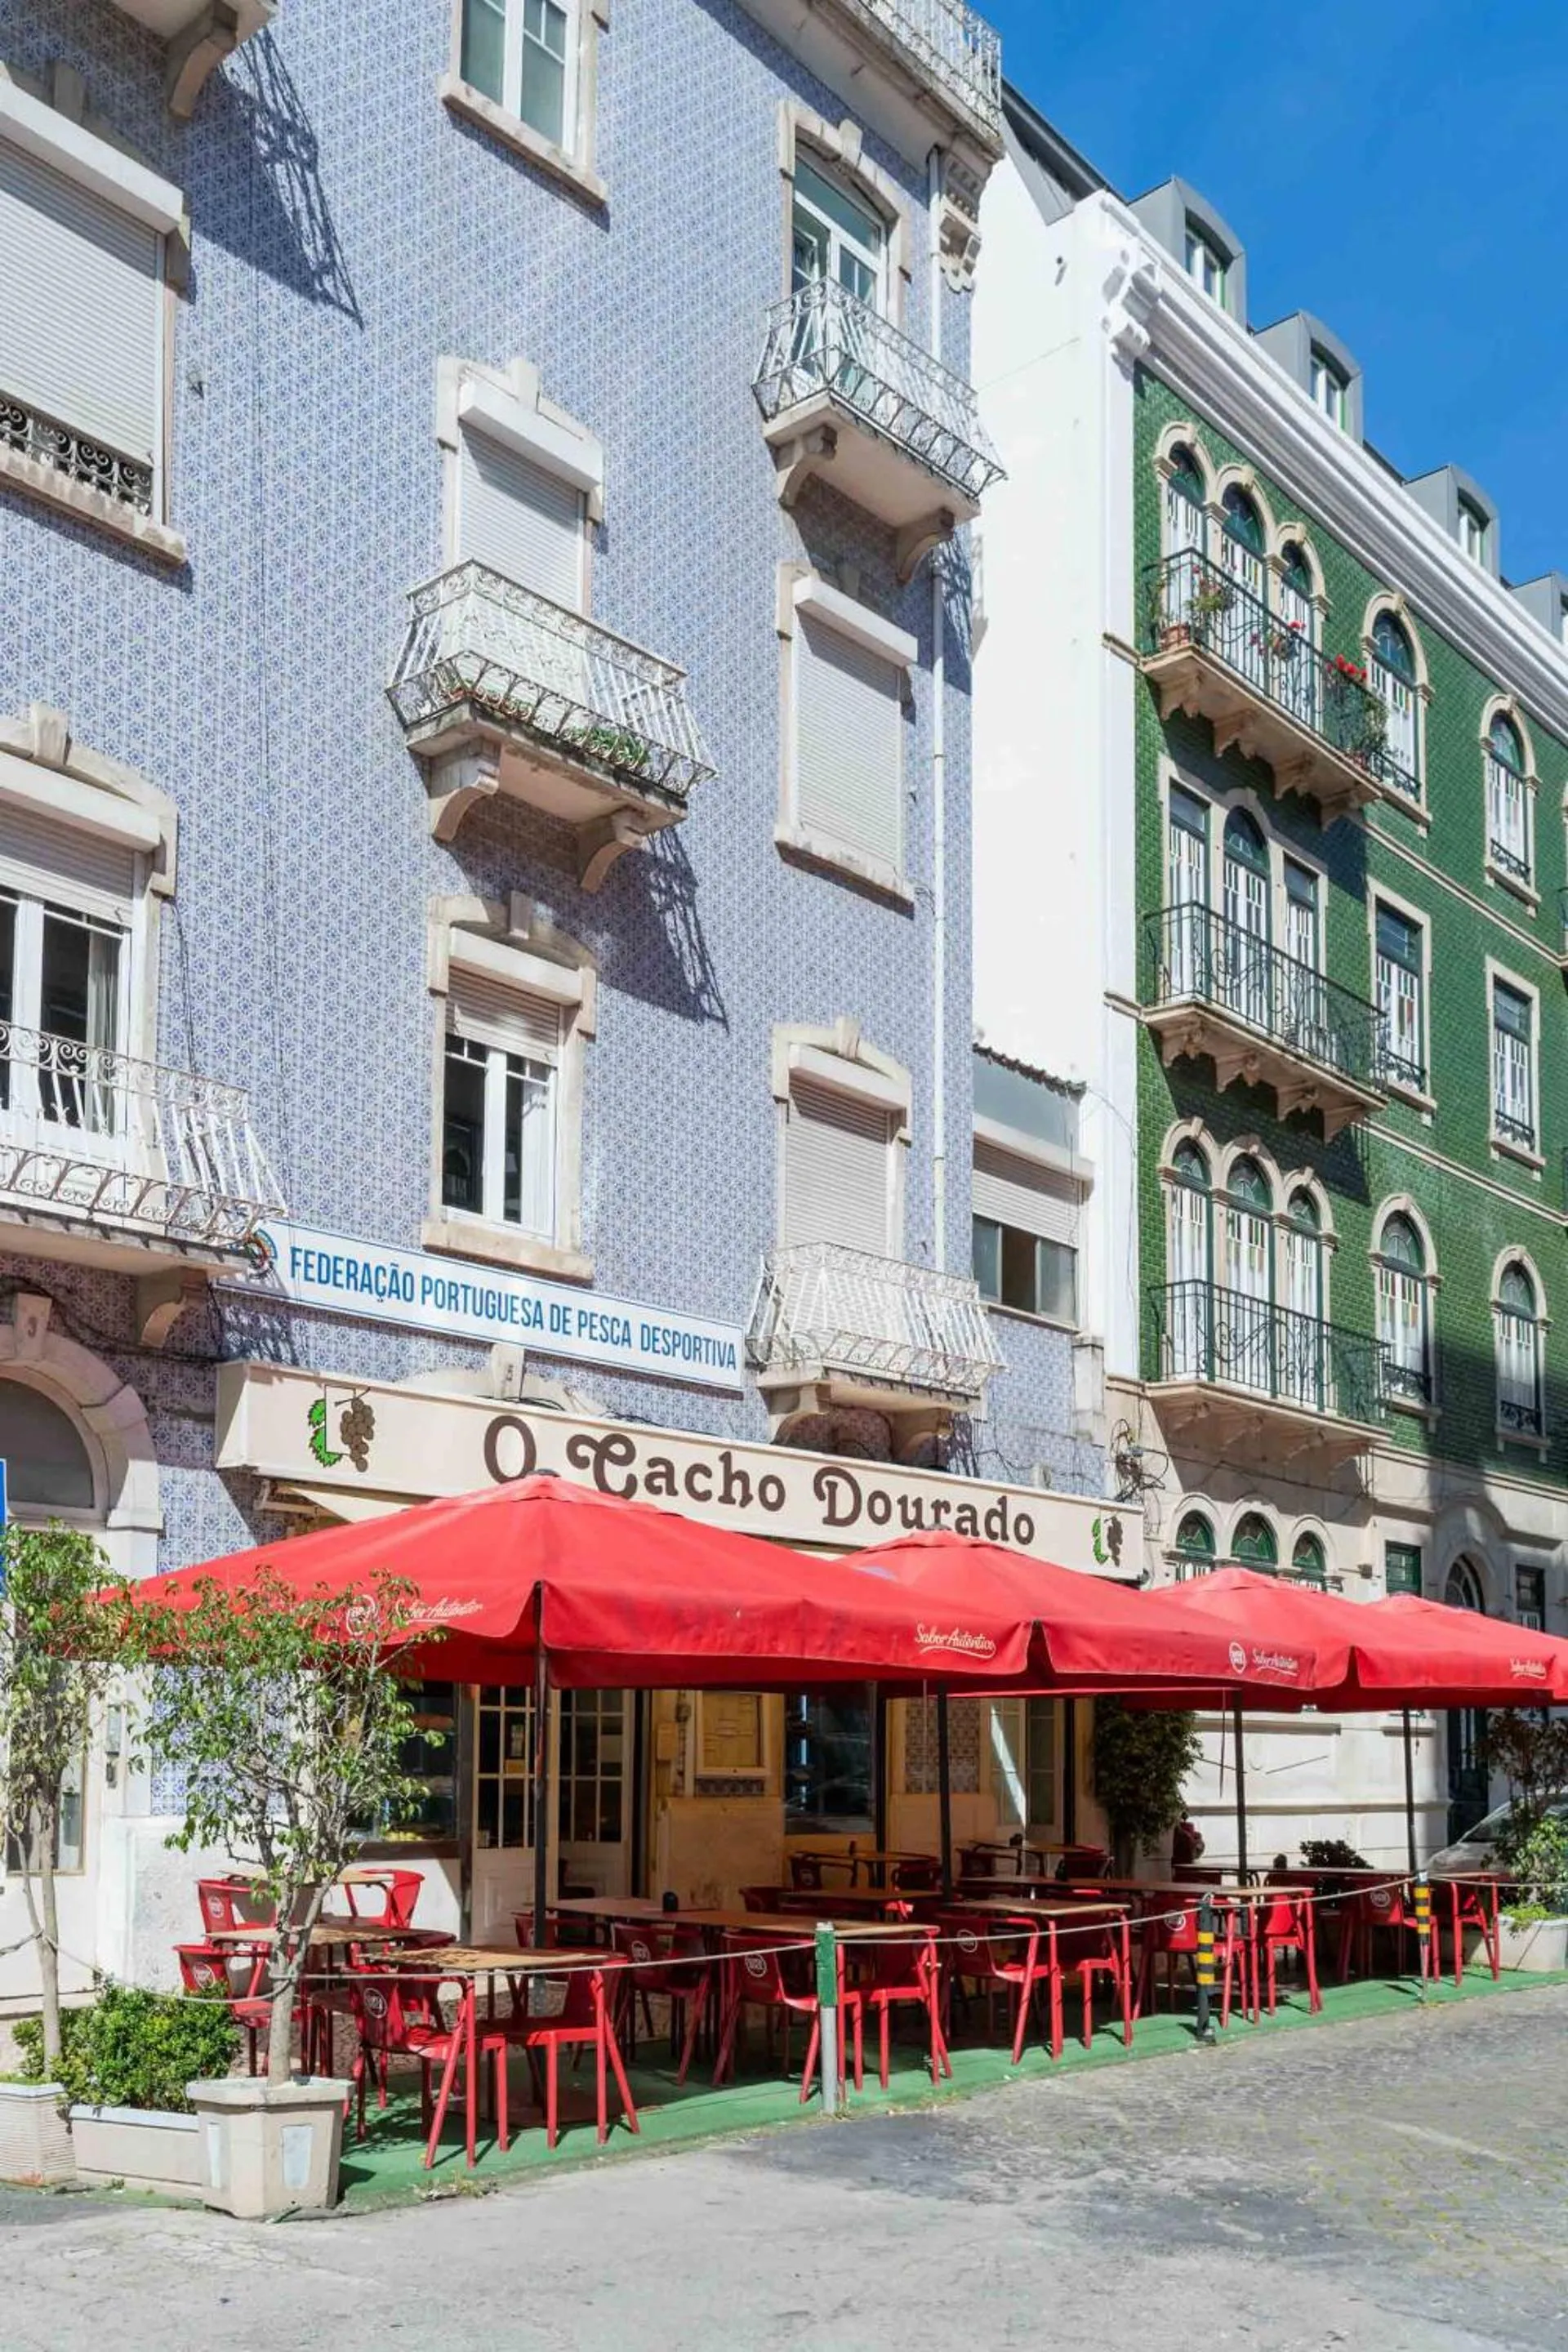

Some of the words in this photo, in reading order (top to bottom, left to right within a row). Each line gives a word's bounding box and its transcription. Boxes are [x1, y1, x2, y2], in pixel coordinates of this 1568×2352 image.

[290, 1246, 415, 1304] FEDERAÇÃO
[421, 1275, 546, 1331] PORTUGUESA
[550, 1305, 572, 1335] DE
[577, 1310, 633, 1348] PESCA
[639, 1322, 737, 1371] DESPORTIVA
[483, 1415, 537, 1485] O
[566, 1432, 786, 1512] Cacho
[813, 1467, 1036, 1546] Dourado
